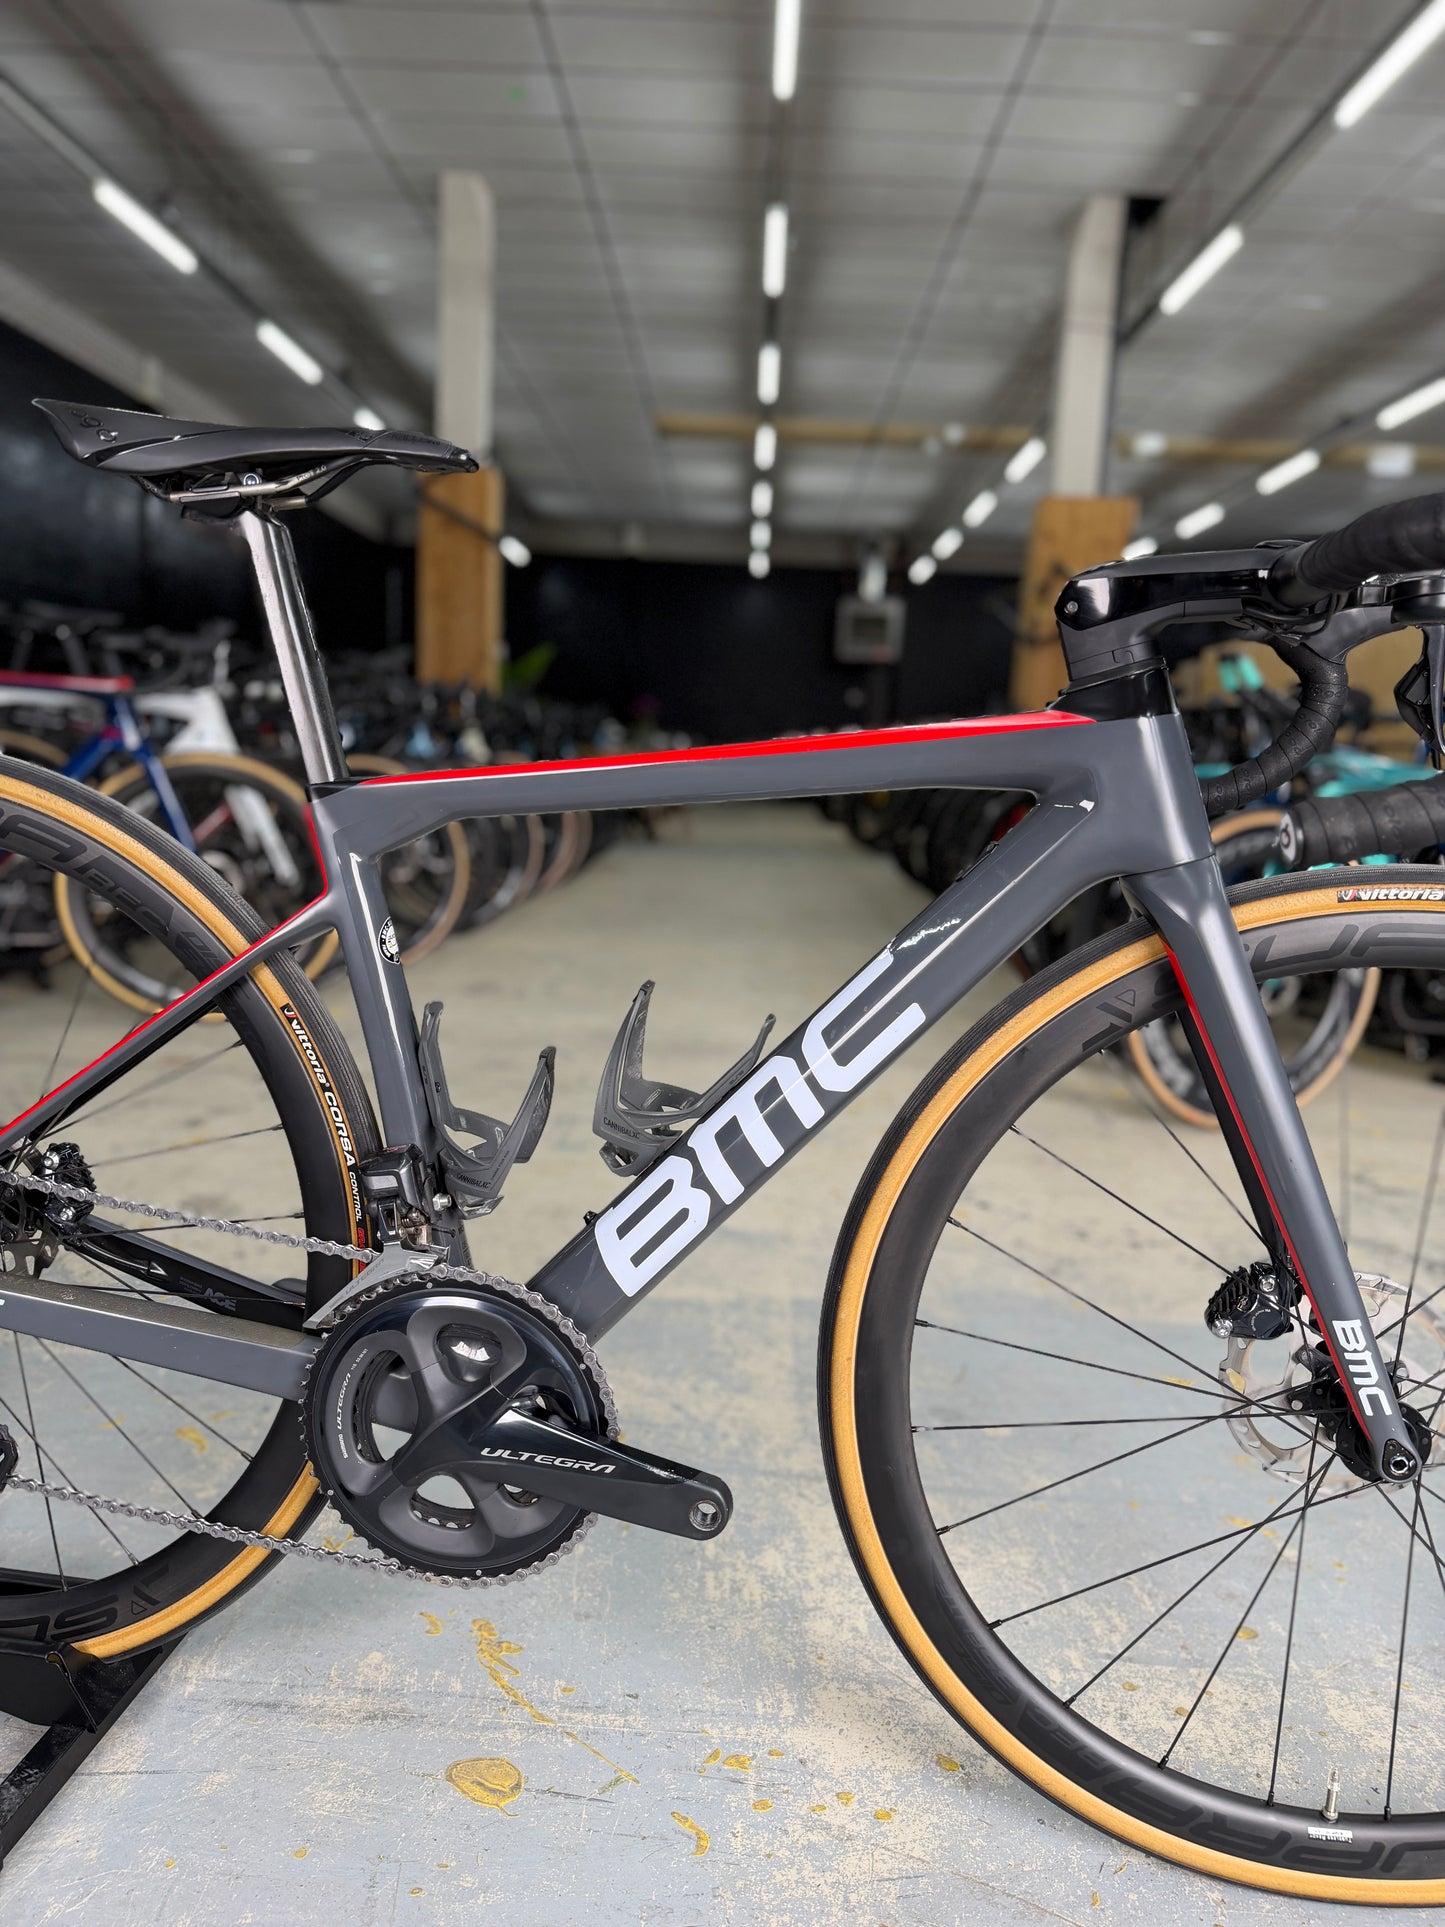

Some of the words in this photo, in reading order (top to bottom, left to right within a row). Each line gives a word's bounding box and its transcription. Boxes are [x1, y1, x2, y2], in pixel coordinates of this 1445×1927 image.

[1358, 886, 1445, 901] vittoria
[290, 1018, 328, 1085] vittoria
[324, 1091, 356, 1167] CORSA
[348, 1171, 364, 1222] CONTROL
[594, 949, 927, 1298] BMC
[336, 1372, 351, 1430] ULTEGRA
[1331, 1319, 1393, 1417] BMC
[480, 1447, 616, 1475] ULTEGRA
